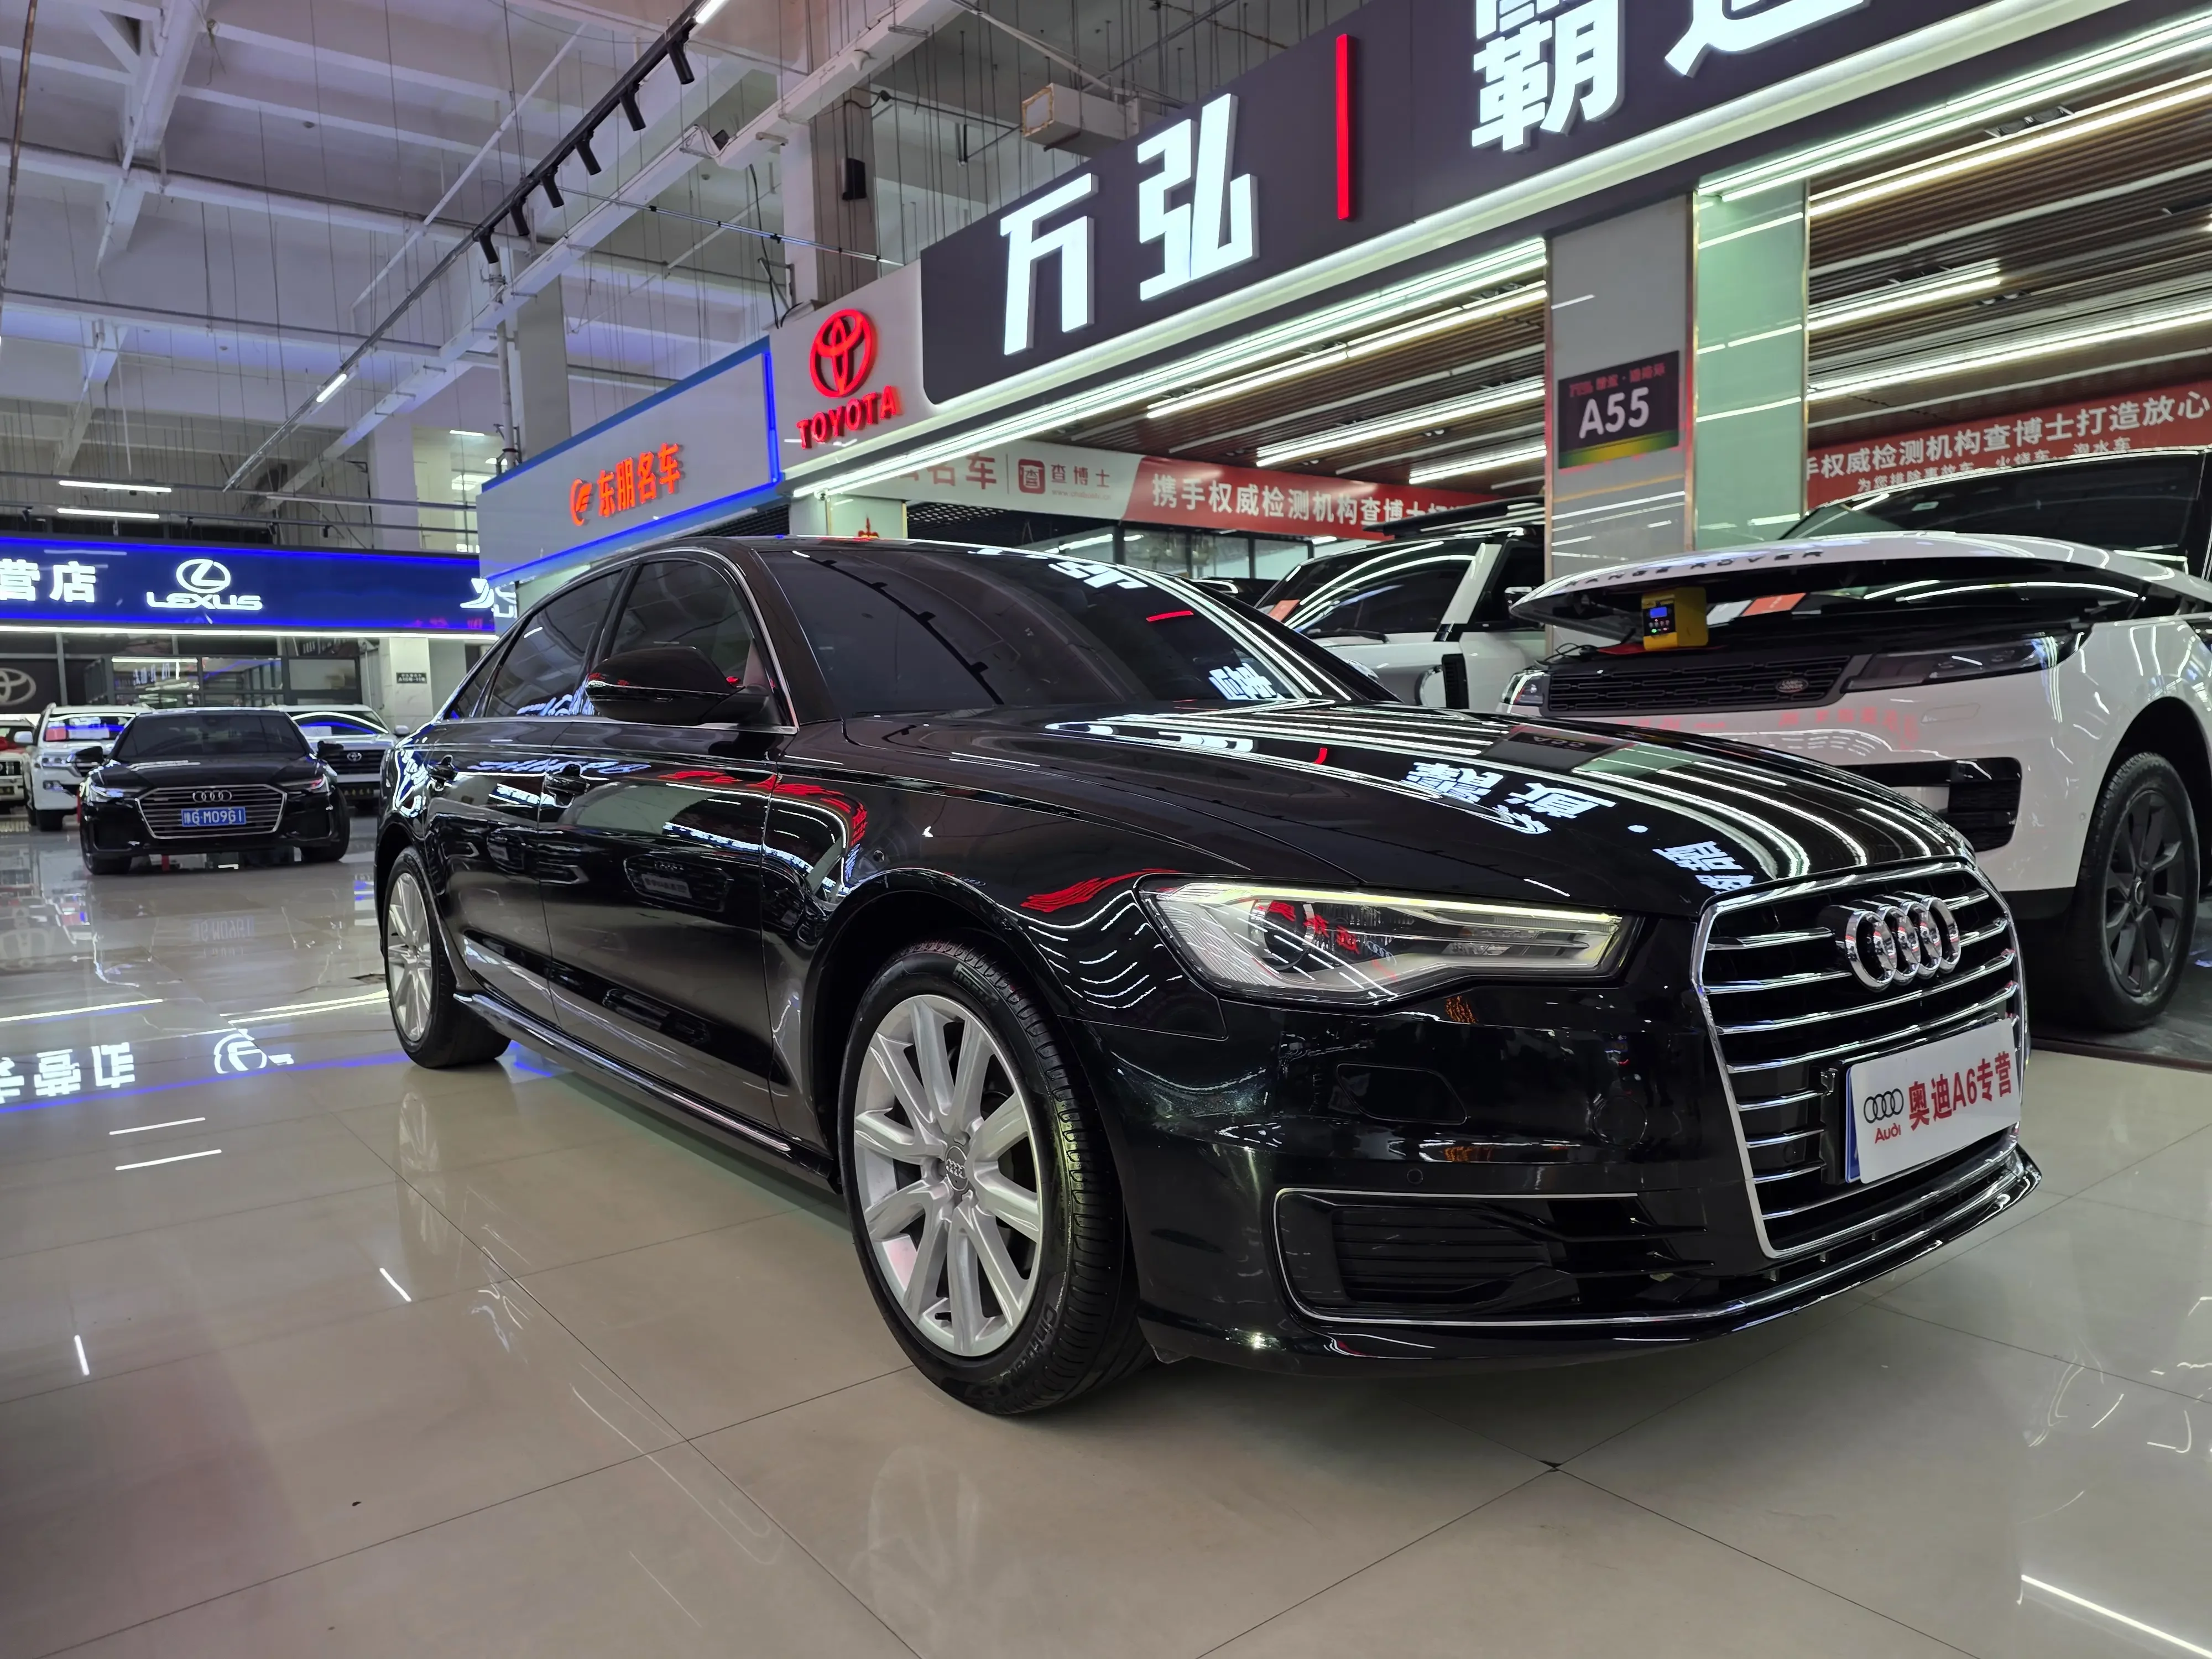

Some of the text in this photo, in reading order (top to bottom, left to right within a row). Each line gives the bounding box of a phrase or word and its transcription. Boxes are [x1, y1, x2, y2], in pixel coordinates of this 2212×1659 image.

[1000, 93, 1255, 356] 万弘
[796, 385, 898, 450] TOYOTA
[1579, 387, 1650, 439] A55
[597, 443, 680, 518] 东朋名车
[900, 452, 997, 489] 名车
[1051, 463, 1110, 487] 查博士
[0, 559, 96, 603] 营店
[146, 591, 263, 611] LEXUS
[1908, 1051, 2012, 1131] 奥迪A6专营
[1874, 1122, 1902, 1144] Audi
